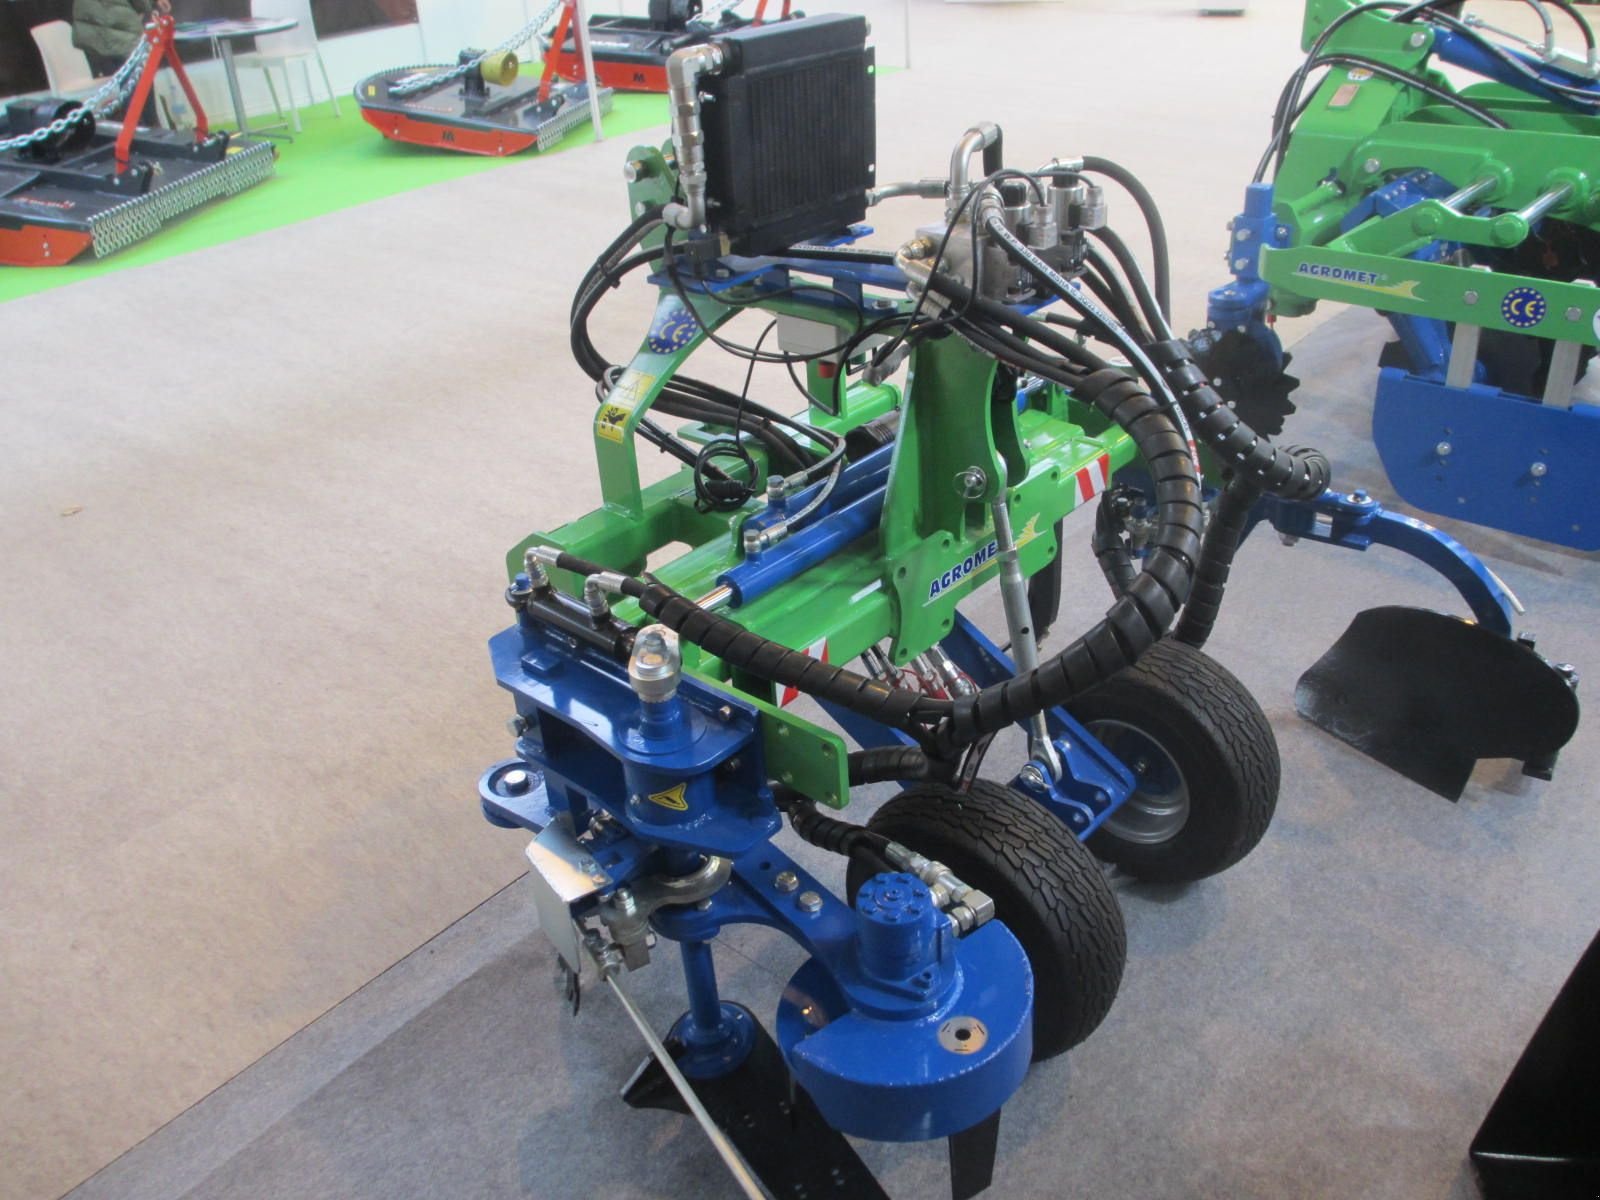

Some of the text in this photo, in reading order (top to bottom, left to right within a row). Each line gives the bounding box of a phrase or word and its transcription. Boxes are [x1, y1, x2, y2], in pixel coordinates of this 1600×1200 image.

[1031, 253, 1049, 272] BAR
[1298, 263, 1378, 285] AGROMET
[1510, 298, 1537, 318] CE
[660, 321, 689, 343] CE
[928, 540, 999, 599] AGROME
